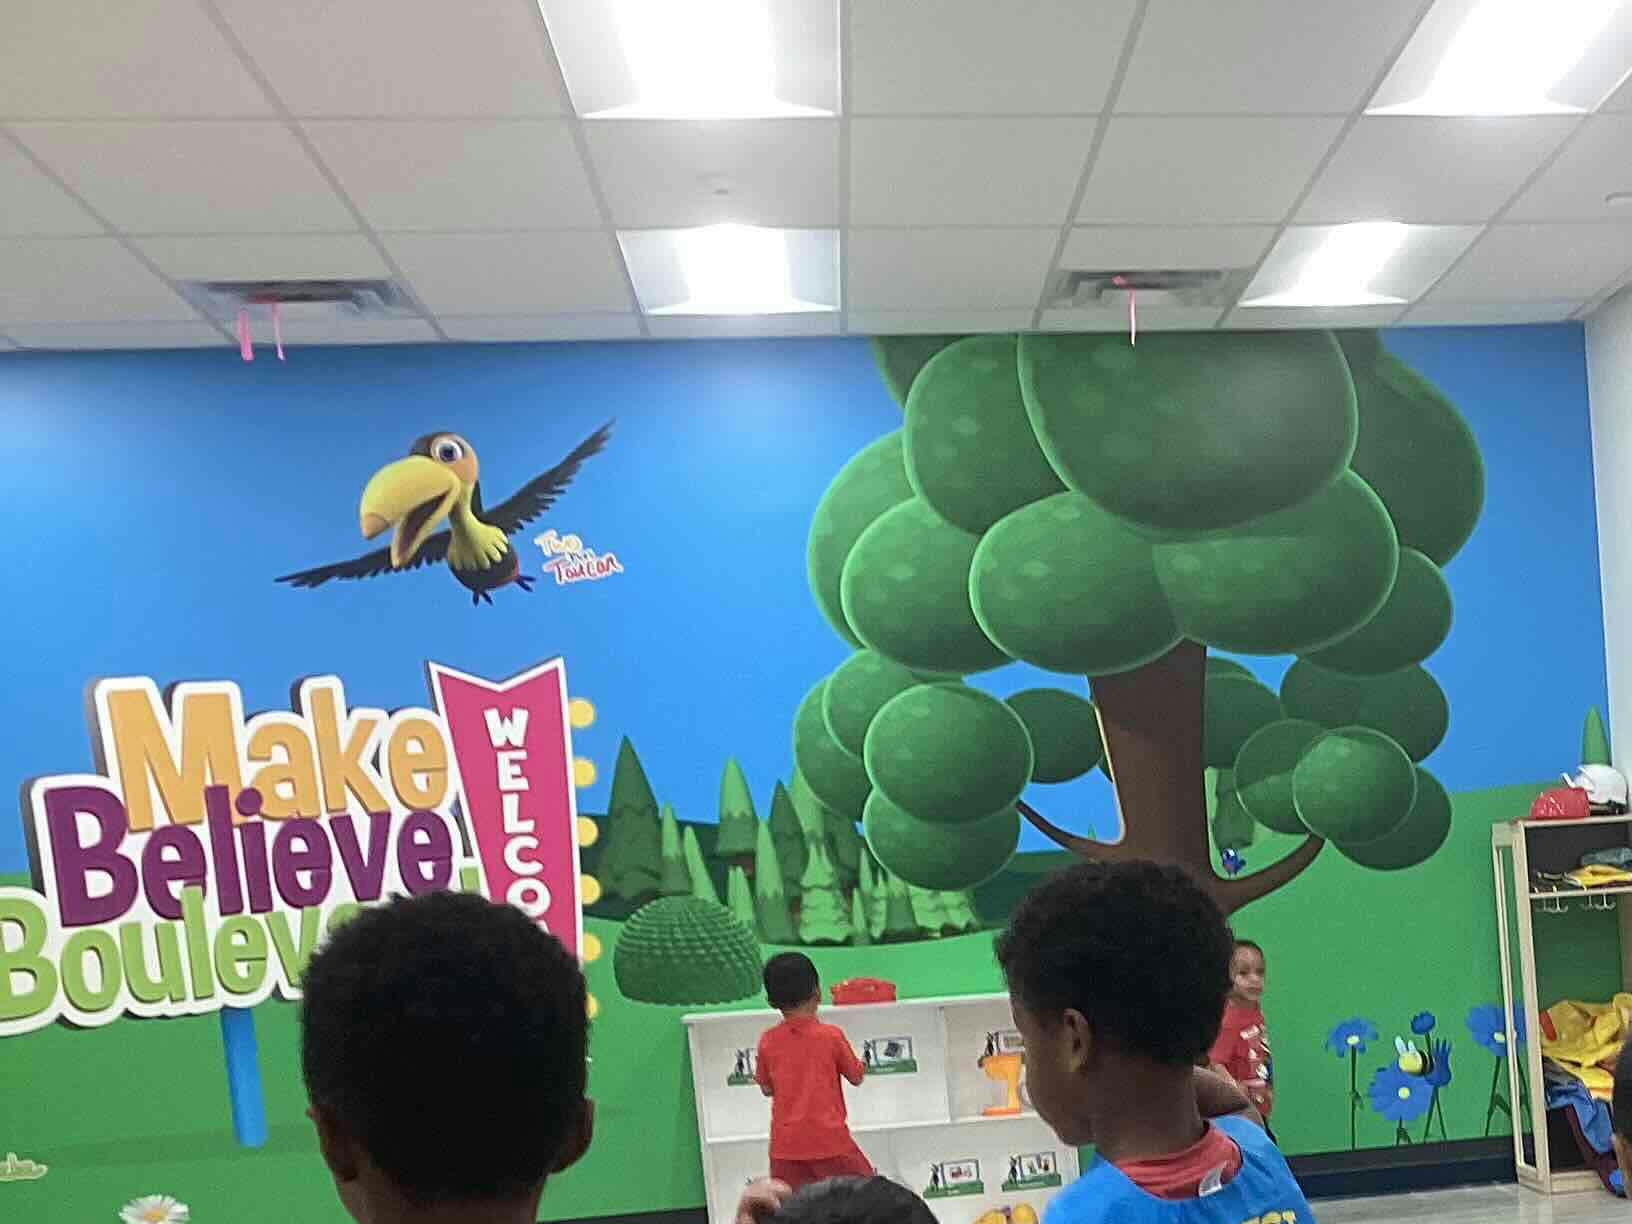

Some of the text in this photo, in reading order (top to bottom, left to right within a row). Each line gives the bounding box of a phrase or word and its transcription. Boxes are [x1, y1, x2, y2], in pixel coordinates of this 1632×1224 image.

[107, 686, 450, 832] Make
[484, 708, 552, 932] WELCO
[44, 784, 454, 928] Believe
